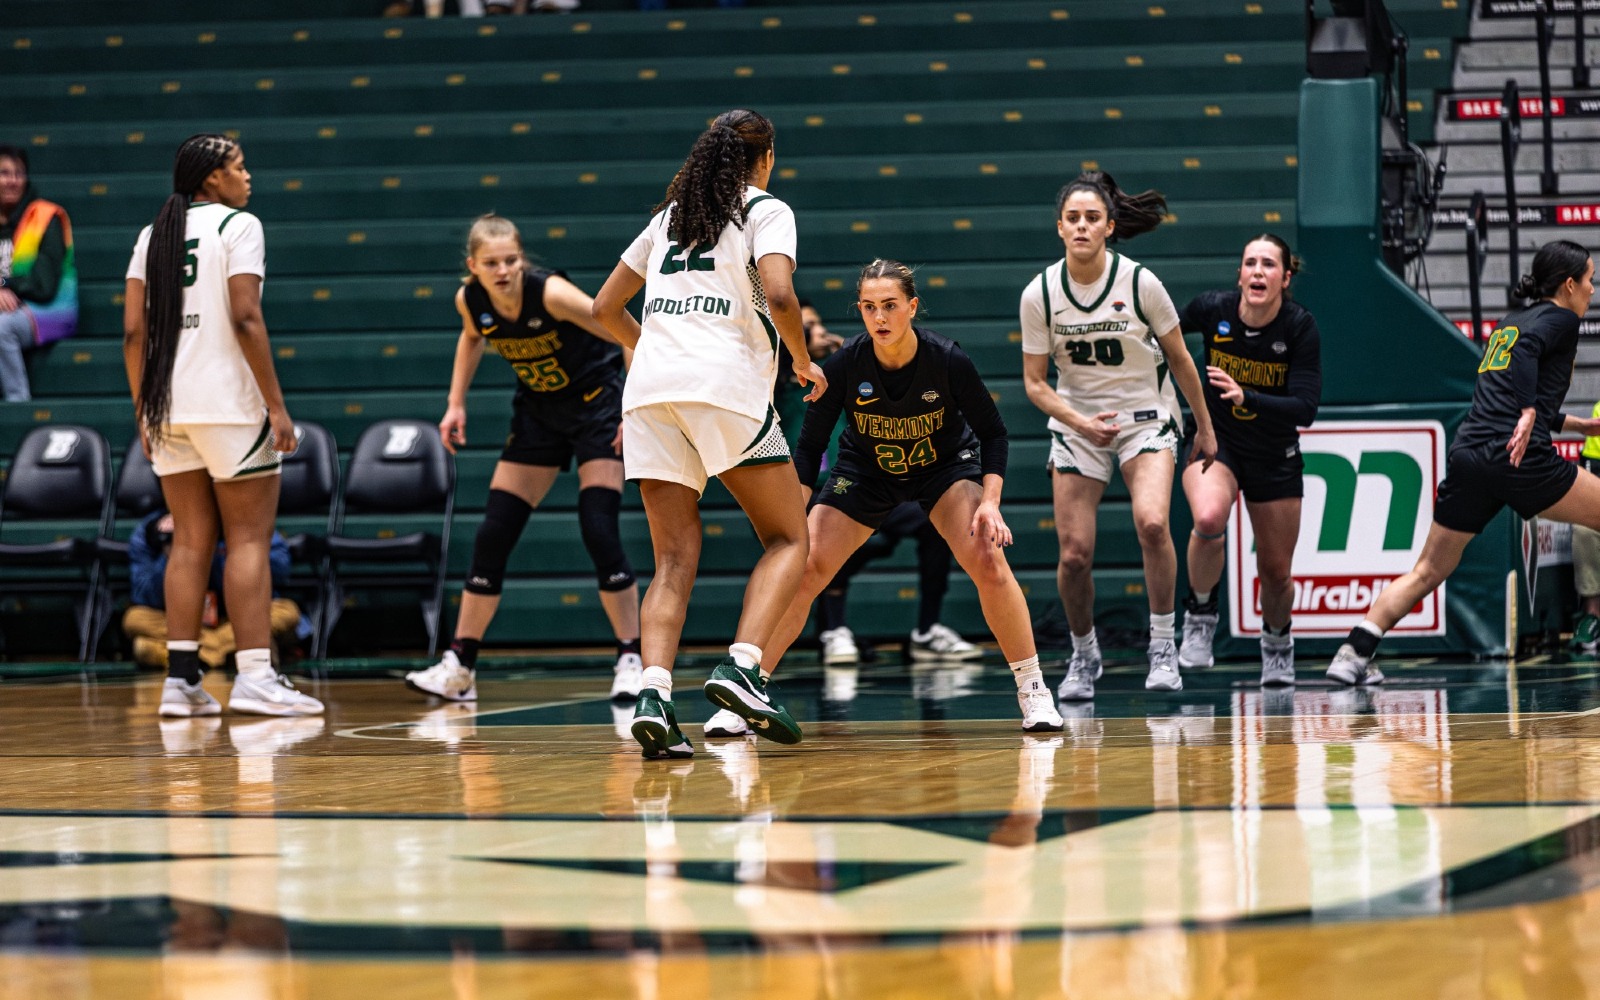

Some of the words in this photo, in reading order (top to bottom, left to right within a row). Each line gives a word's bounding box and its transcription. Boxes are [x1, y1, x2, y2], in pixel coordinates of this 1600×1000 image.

[1462, 101, 1491, 116] BAE
[1562, 206, 1591, 221] BAE
[644, 295, 731, 322] MIDDLETON
[1055, 321, 1129, 336] BINGHAMTON
[1065, 338, 1125, 366] 20
[1478, 325, 1519, 373] 12
[512, 357, 570, 392] 25
[853, 406, 945, 440] VERMONT
[874, 437, 937, 475] 24
